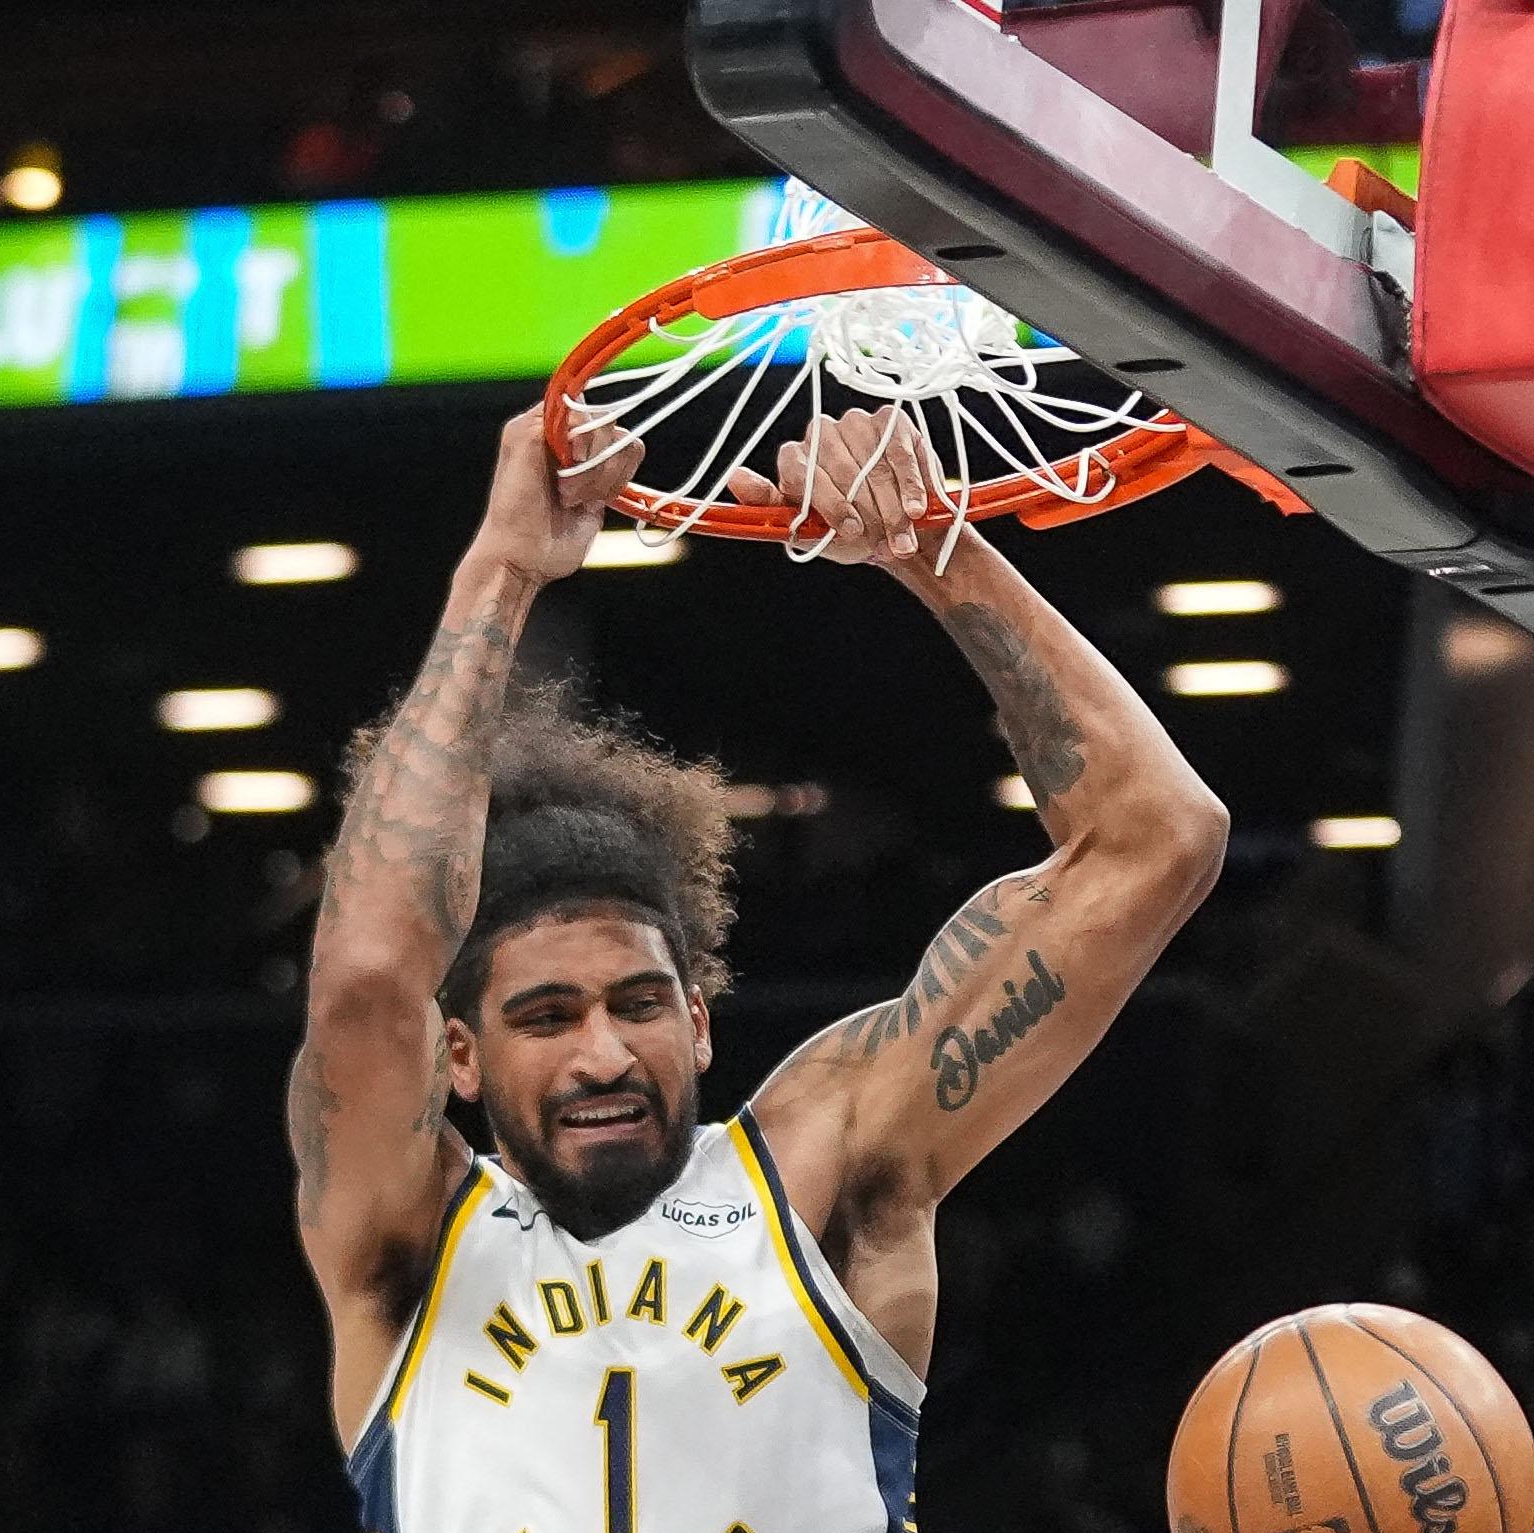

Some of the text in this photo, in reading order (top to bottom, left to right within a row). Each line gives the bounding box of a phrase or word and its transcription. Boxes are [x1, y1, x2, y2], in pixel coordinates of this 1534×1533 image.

[930, 949, 1066, 1112] Daniel
[662, 1202, 757, 1227] LUCAS OIL
[463, 1255, 788, 1409] INDIANA
